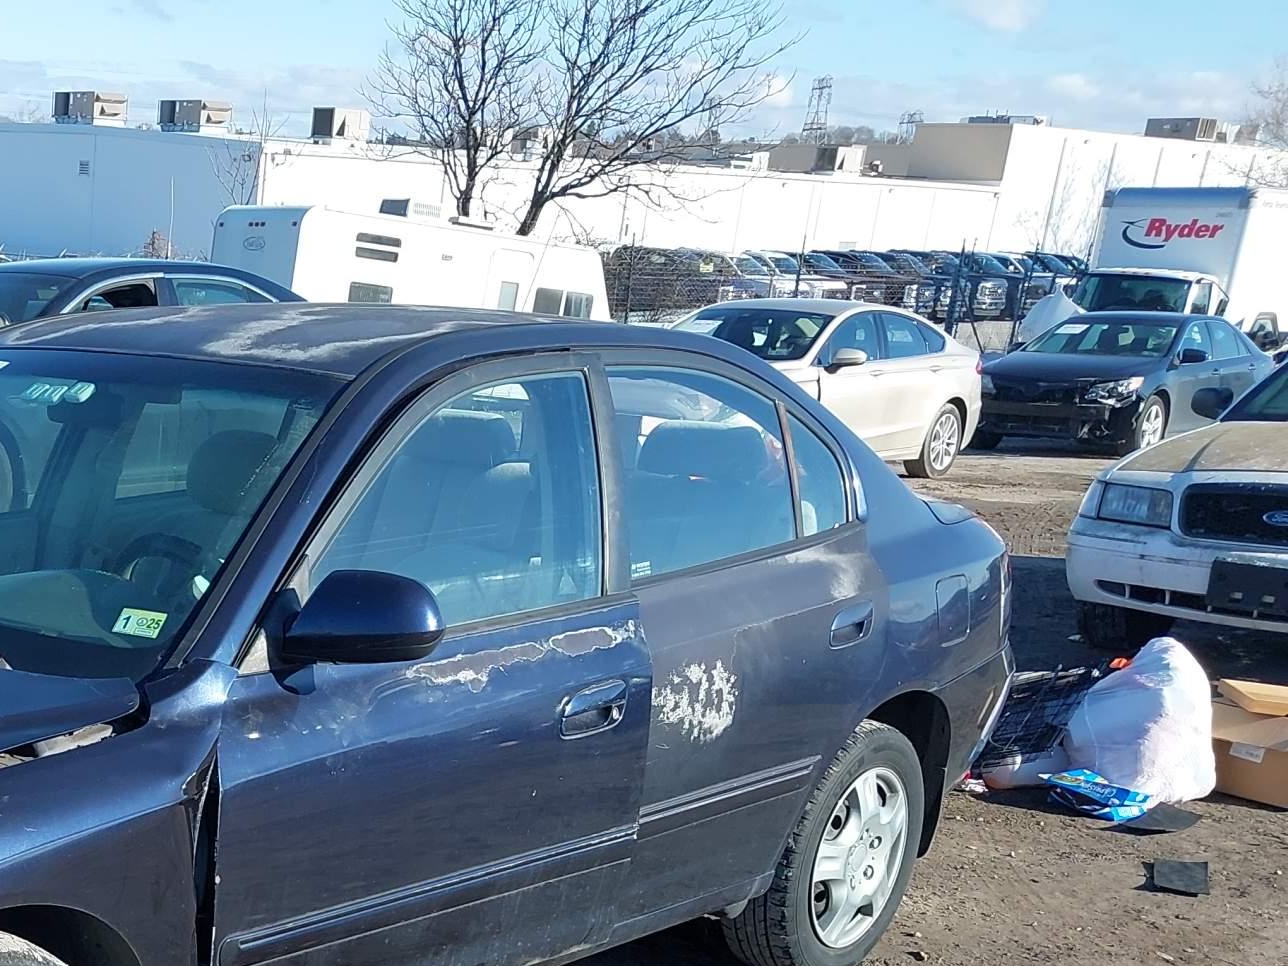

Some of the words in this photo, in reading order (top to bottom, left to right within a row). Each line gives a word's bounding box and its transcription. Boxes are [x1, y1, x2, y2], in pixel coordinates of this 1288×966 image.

[1144, 218, 1225, 242] Ryder
[122, 615, 132, 629] 1
[146, 617, 163, 630] 25
